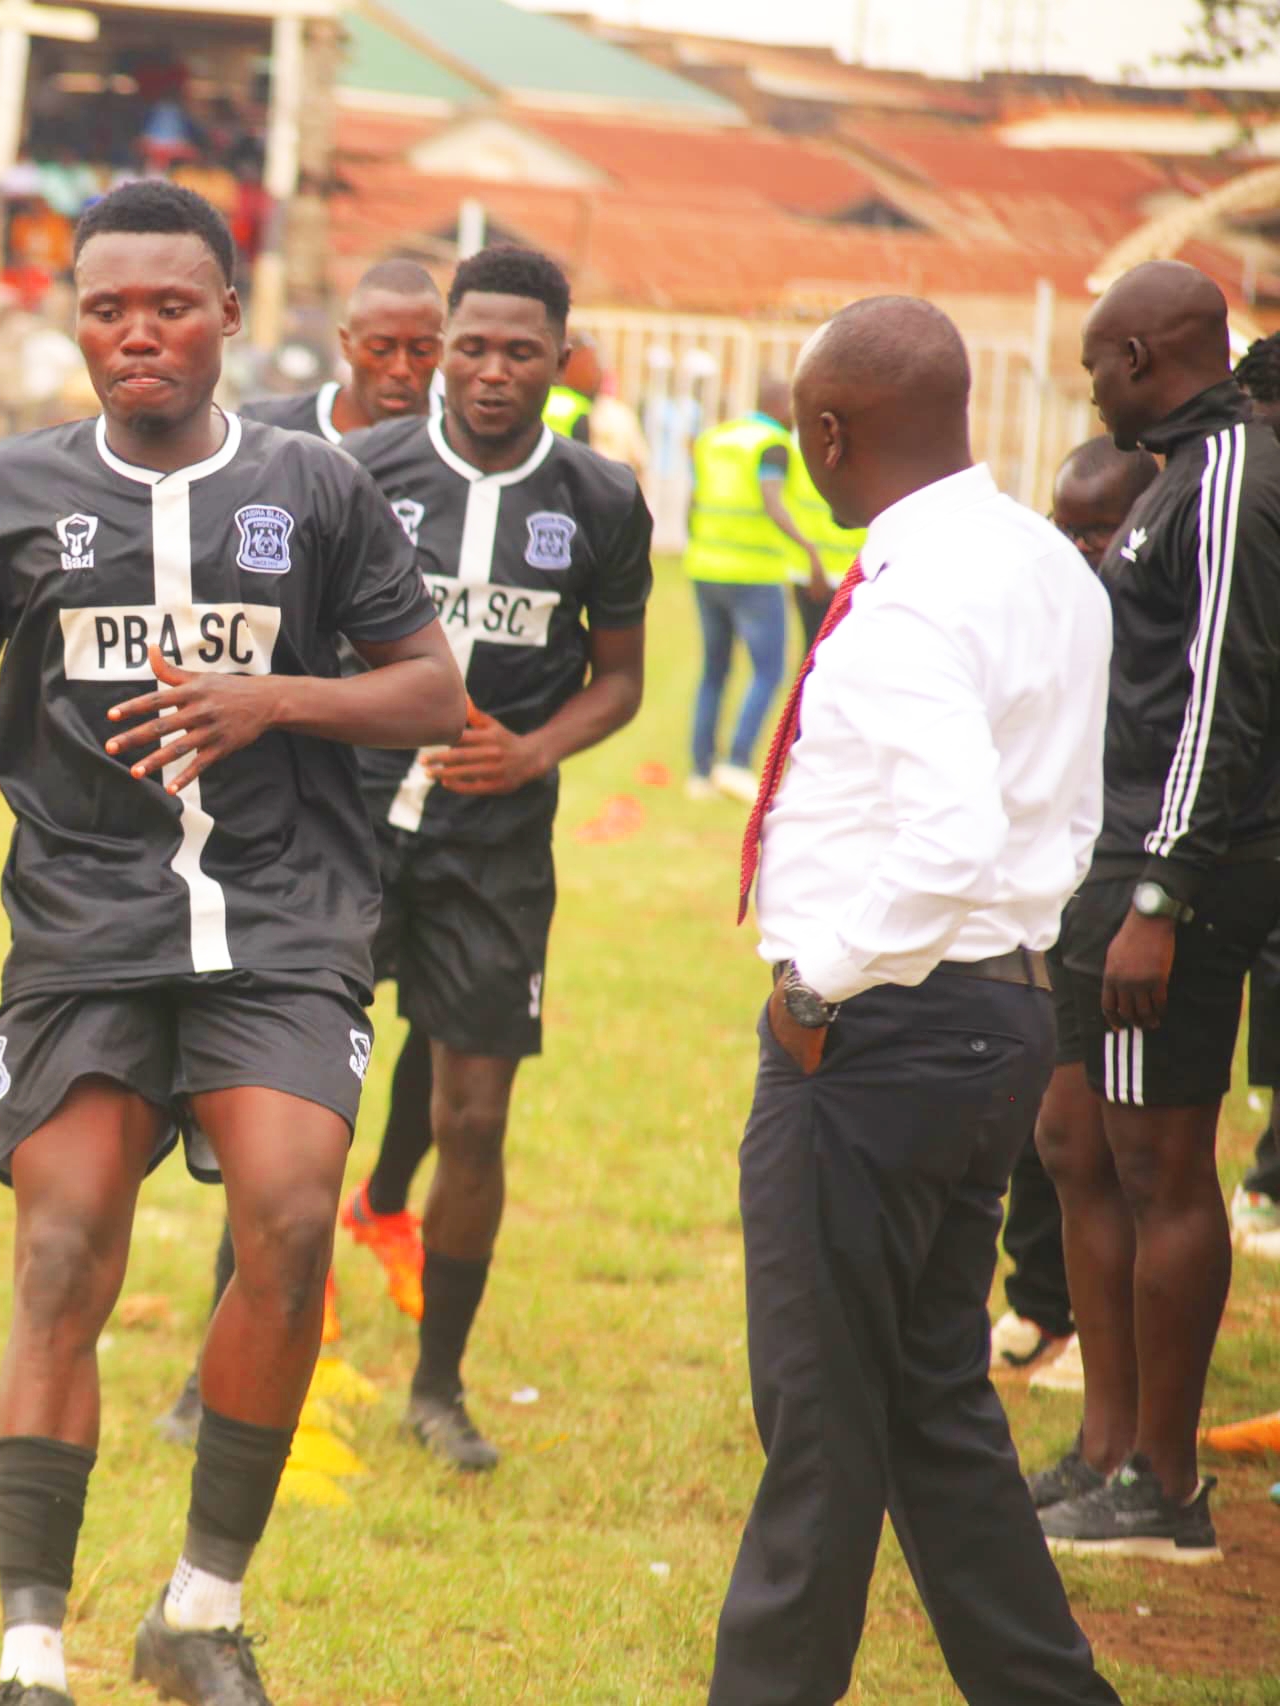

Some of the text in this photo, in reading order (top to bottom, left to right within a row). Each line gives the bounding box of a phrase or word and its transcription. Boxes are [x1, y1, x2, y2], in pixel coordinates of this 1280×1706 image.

[483, 591, 531, 636] SC
[94, 612, 253, 669] PBA SC
